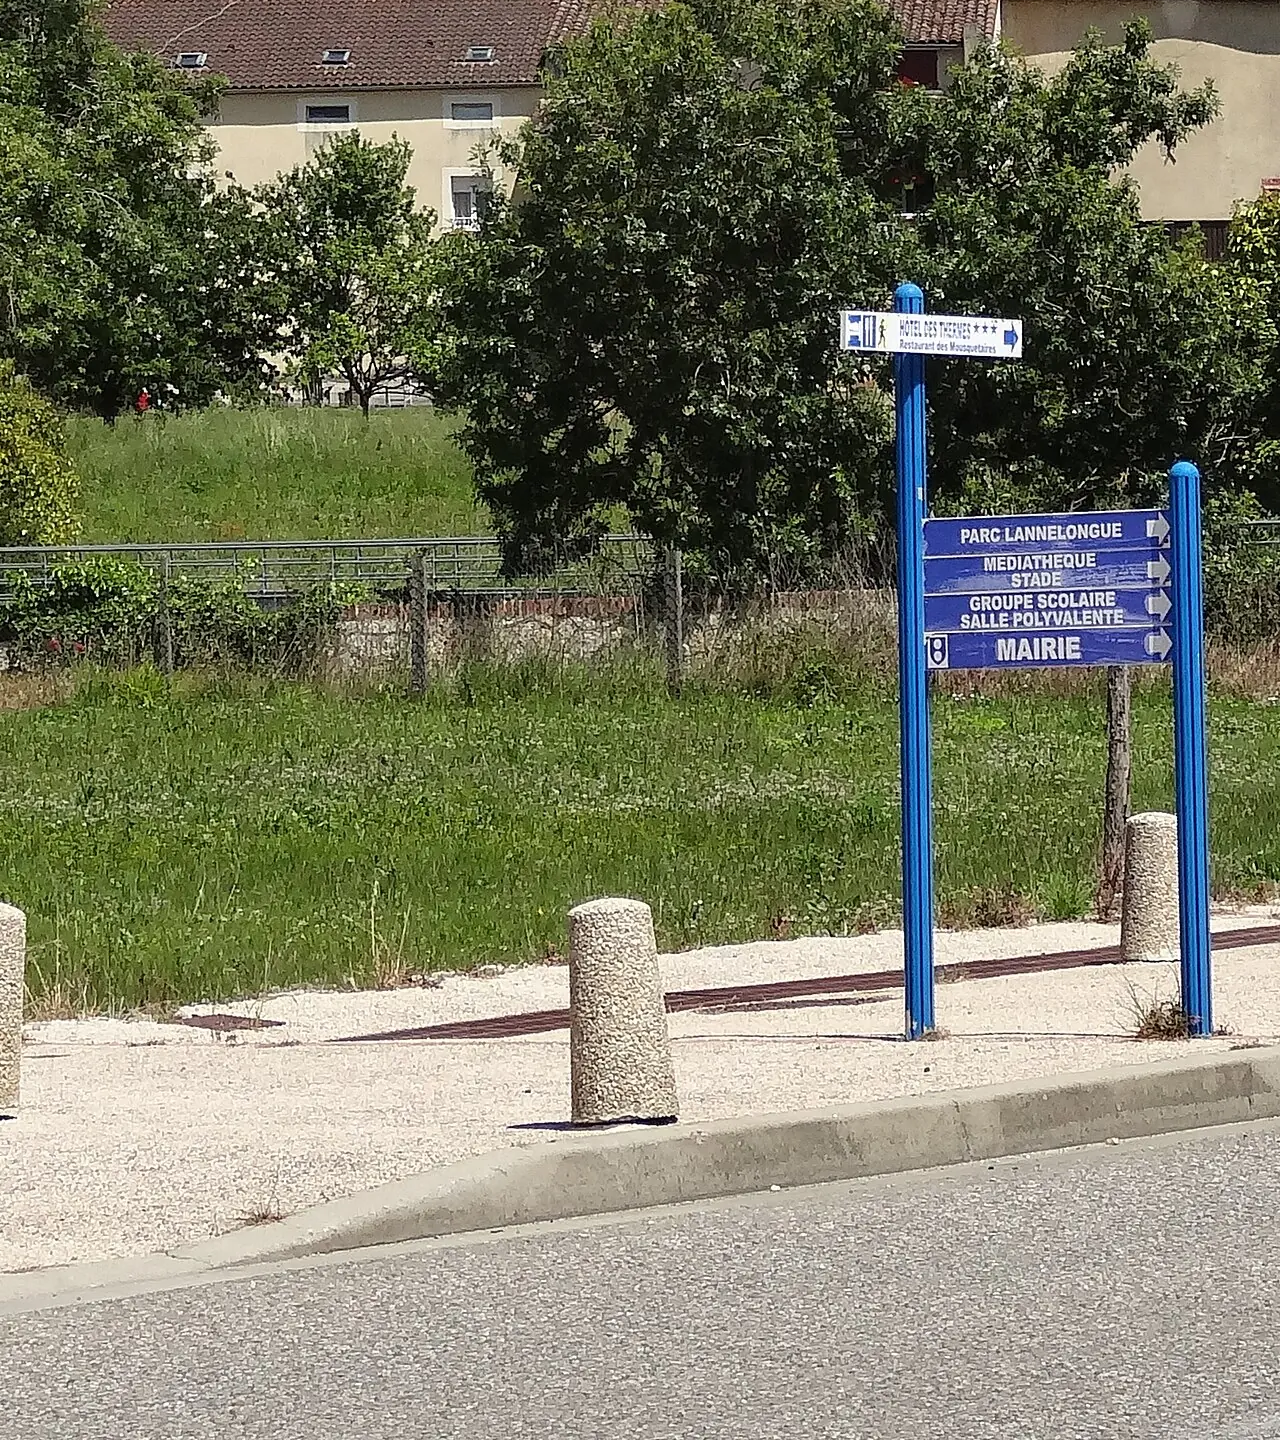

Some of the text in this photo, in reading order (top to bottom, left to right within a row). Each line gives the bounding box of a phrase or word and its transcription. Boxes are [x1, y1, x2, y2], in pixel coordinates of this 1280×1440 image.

[899, 339, 997, 355] Restaurant des Mousquetaires
[960, 523, 1122, 544] PARC LANNELONGUE
[983, 553, 1096, 572] MEDIATHEQUE
[1011, 572, 1062, 588] STADE
[969, 591, 1116, 612] GROUPE SCOLAIRE
[960, 608, 1124, 630] SALLE POLYVALENTE
[997, 636, 1081, 661] MAIRIE
